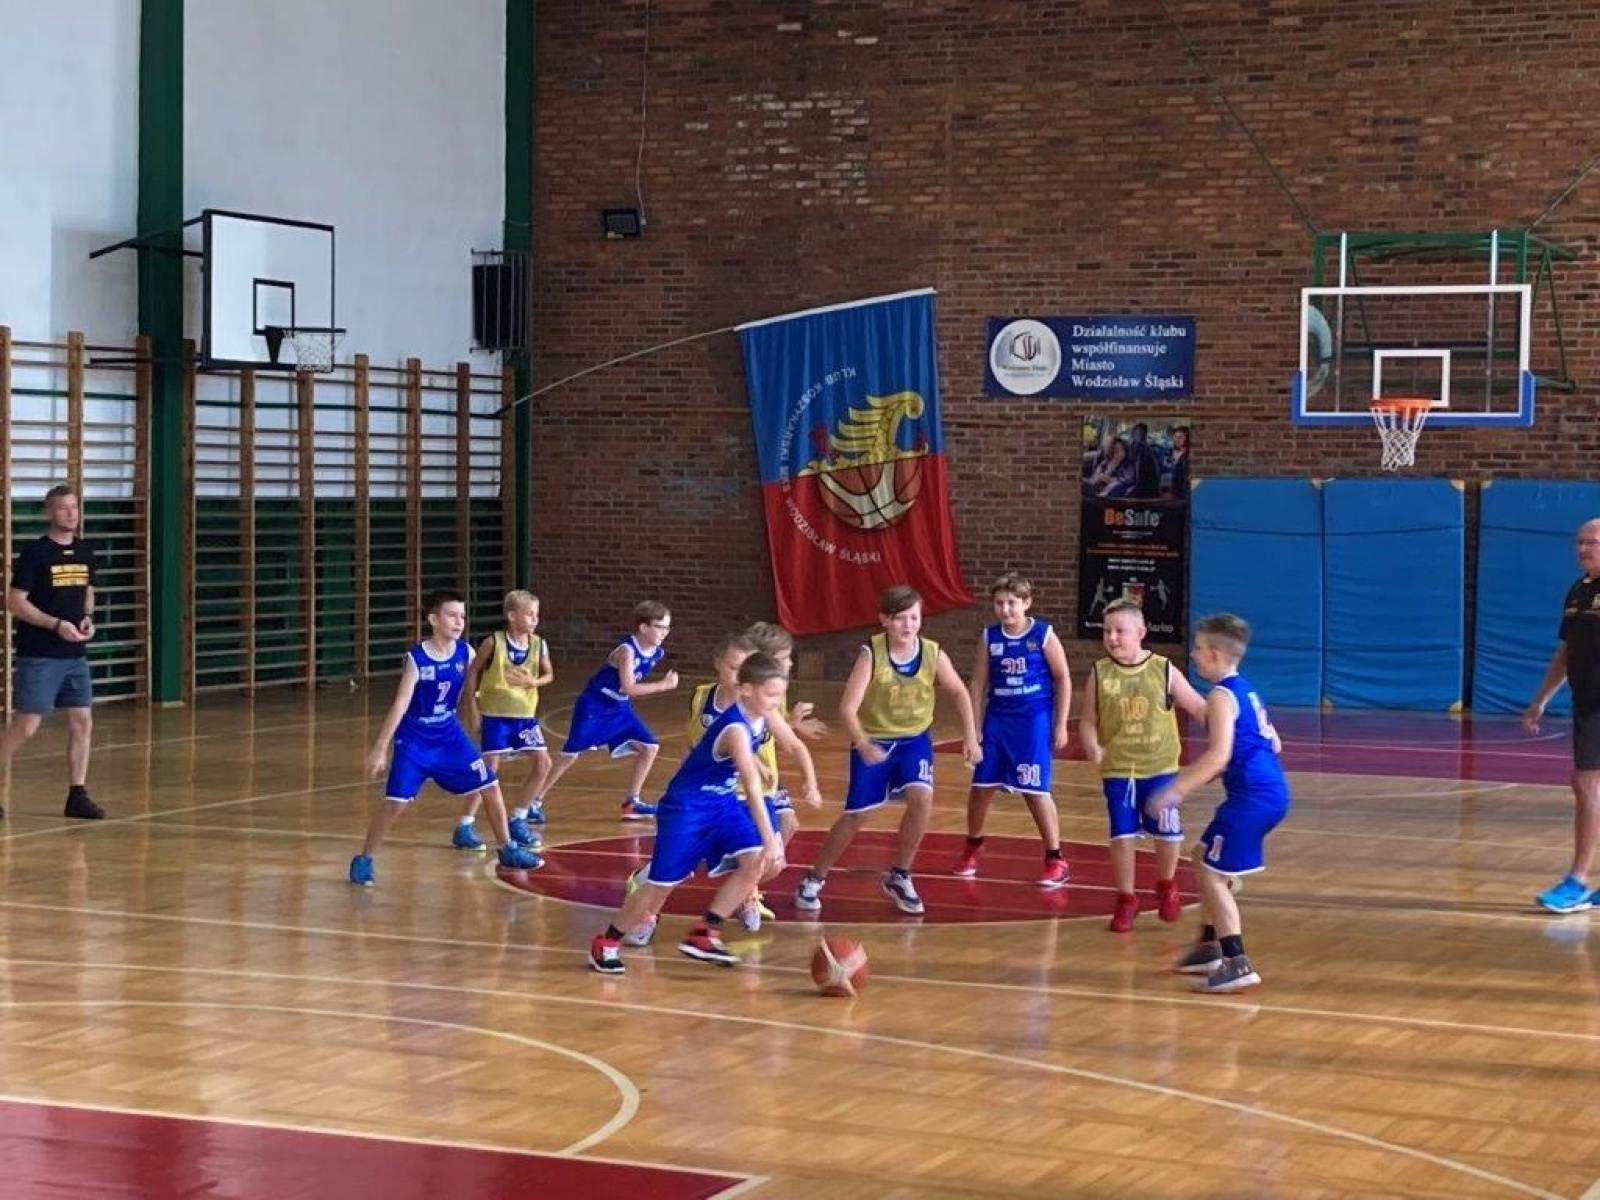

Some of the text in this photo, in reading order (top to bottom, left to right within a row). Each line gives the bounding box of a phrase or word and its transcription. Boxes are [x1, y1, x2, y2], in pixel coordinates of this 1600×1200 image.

[1072, 324, 1187, 337] Działalność klubu
[1072, 341, 1168, 357] współfinansuje
[1072, 358, 1115, 371] Miasto
[1072, 372, 1184, 390] Wodzisław Śląski
[1104, 508, 1161, 527] BeSafe
[1000, 657, 1028, 675] 31
[437, 681, 451, 702] 7
[1119, 696, 1149, 721] 10
[470, 758, 488, 782] 7
[1016, 763, 1042, 787] 31
[1207, 835, 1224, 862] 1
